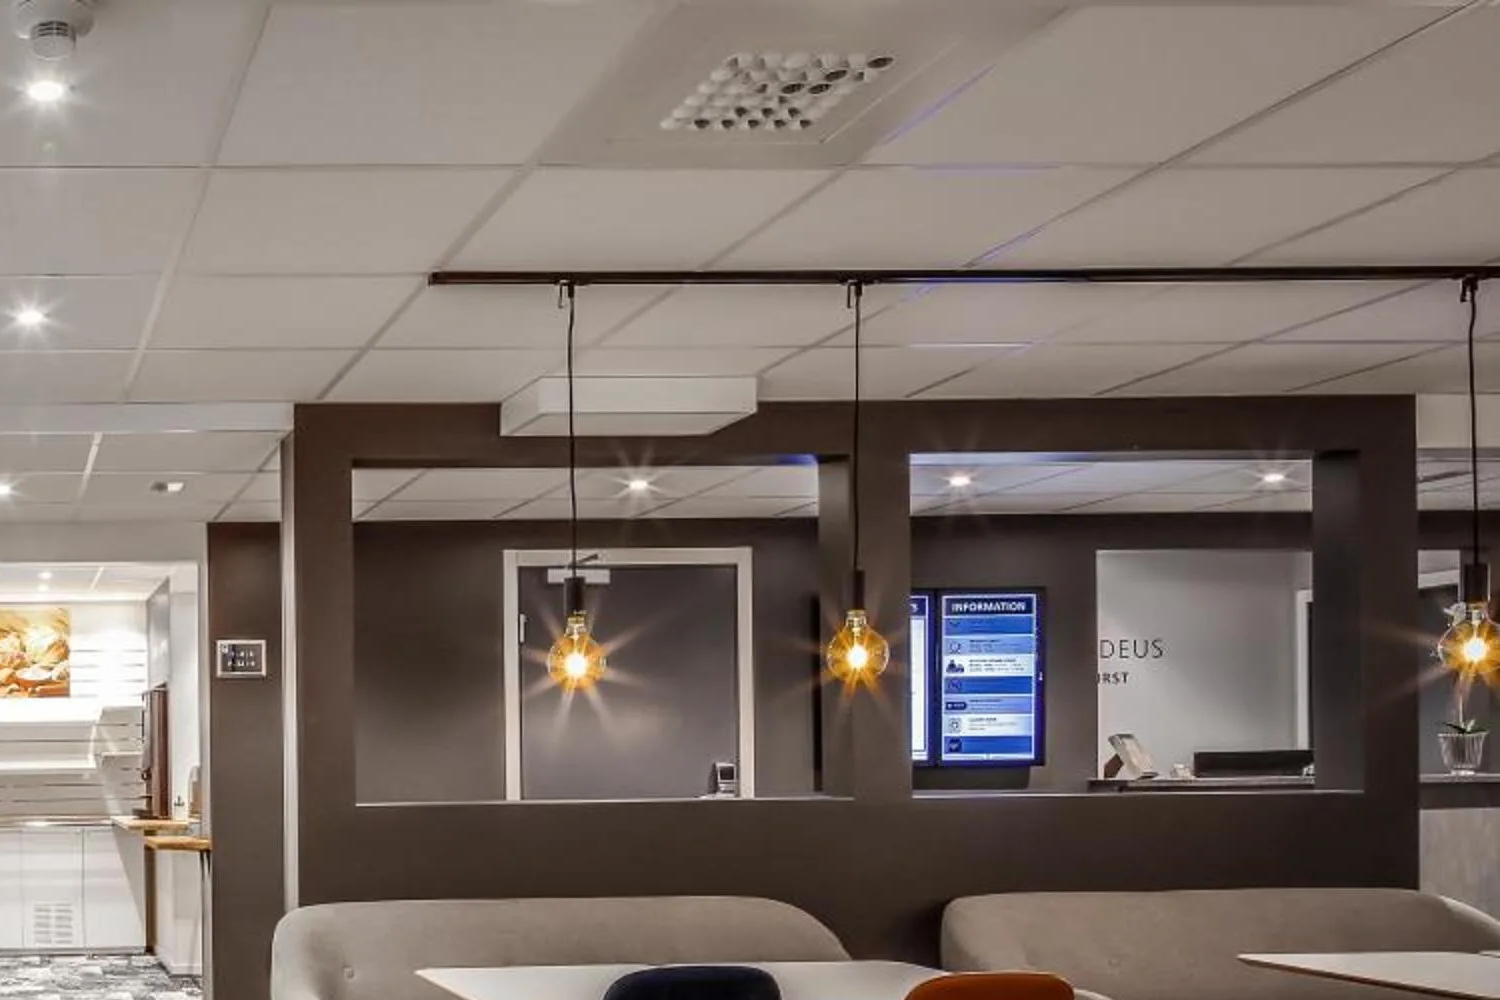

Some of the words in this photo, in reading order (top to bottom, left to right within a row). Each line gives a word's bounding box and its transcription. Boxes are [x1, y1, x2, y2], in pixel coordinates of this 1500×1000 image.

[951, 602, 1026, 612] INFORMATION
[1100, 638, 1163, 658] DEUS
[1097, 672, 1128, 684] IRST
